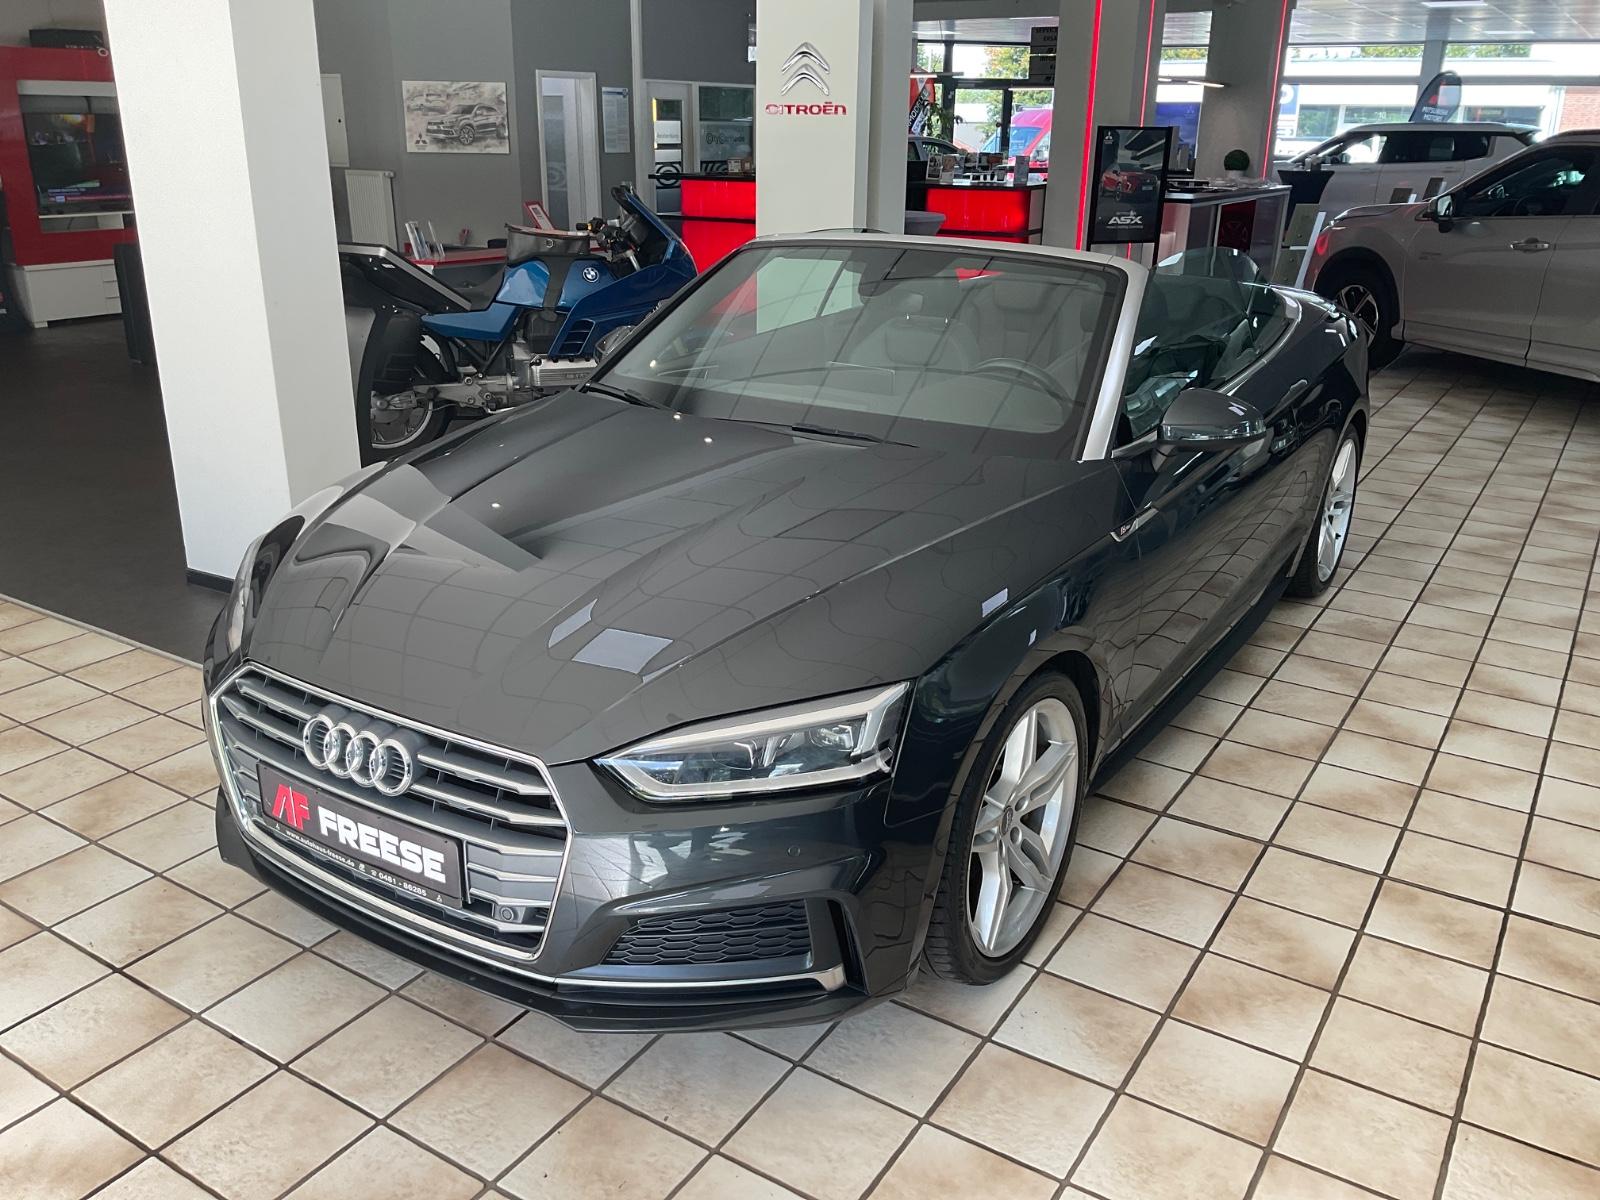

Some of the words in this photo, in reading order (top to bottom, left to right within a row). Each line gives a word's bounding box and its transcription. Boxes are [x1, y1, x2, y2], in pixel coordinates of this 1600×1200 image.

[1107, 215, 1143, 225] ASX
[272, 783, 310, 830] AF
[317, 805, 446, 884] FREESE
[378, 872, 396, 885] 0481
